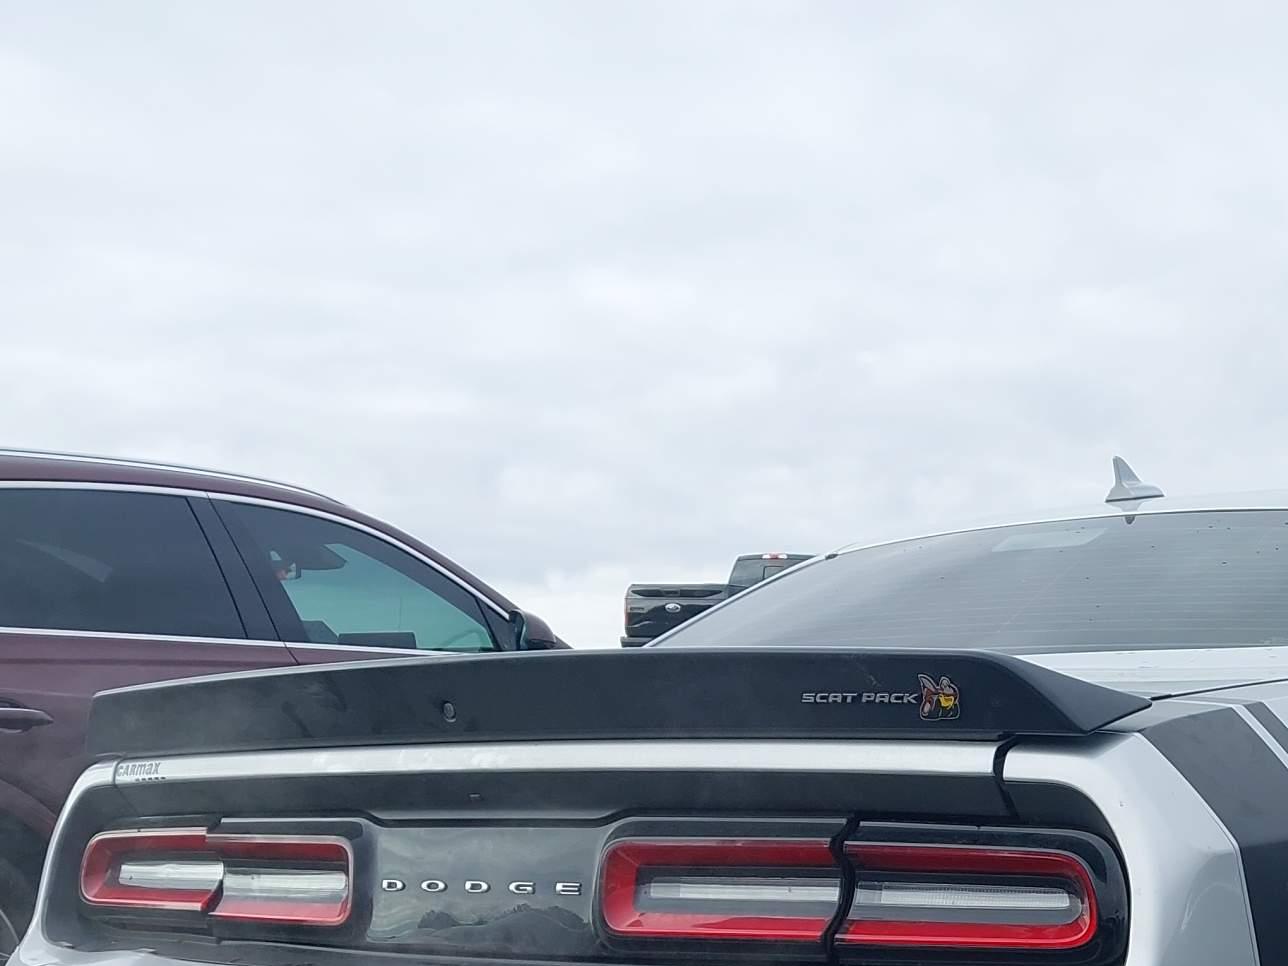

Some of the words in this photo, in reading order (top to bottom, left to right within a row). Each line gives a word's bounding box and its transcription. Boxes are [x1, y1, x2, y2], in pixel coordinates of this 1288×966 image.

[801, 692, 858, 703] SCAT
[861, 692, 919, 704] PACK
[381, 879, 583, 896] DODGE
